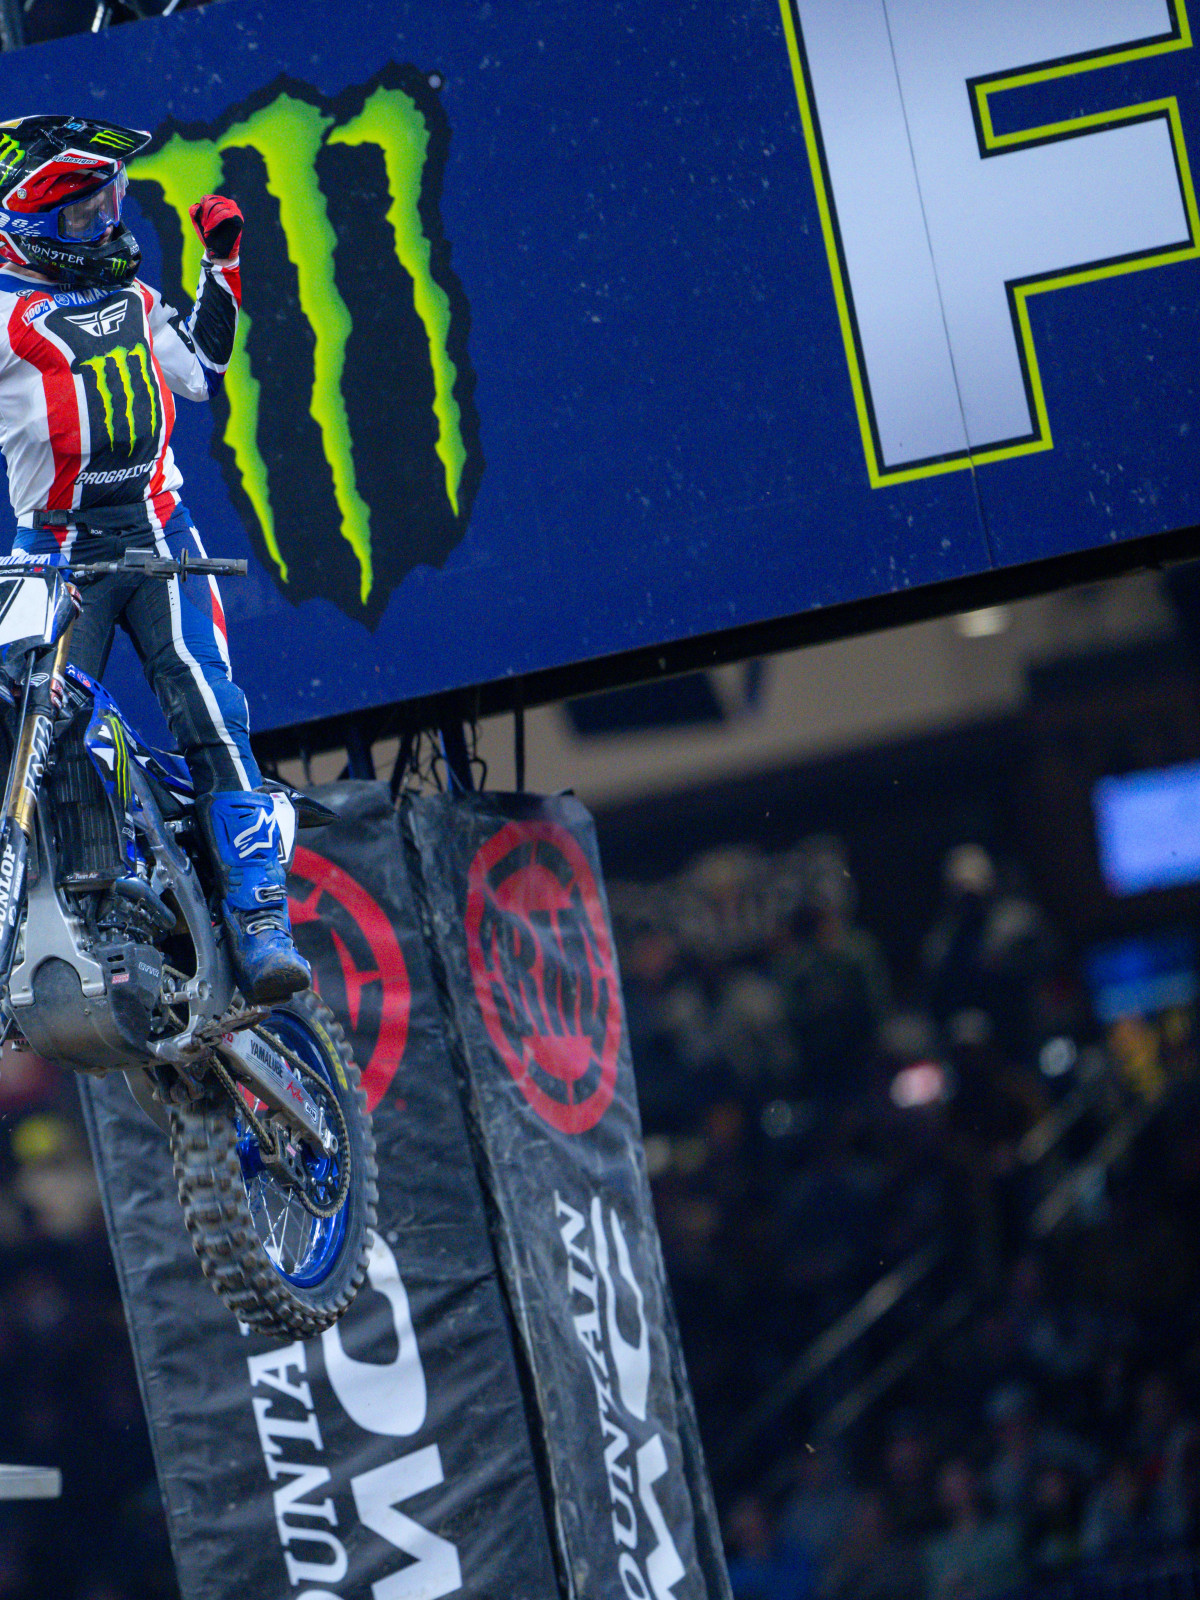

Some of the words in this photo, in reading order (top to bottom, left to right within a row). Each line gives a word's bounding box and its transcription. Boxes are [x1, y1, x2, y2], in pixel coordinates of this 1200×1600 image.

[21, 241, 85, 266] MONSTER
[780, 0, 1200, 490] F
[24, 299, 50, 323] 100%
[250, 1039, 285, 1079] YAMALUBE
